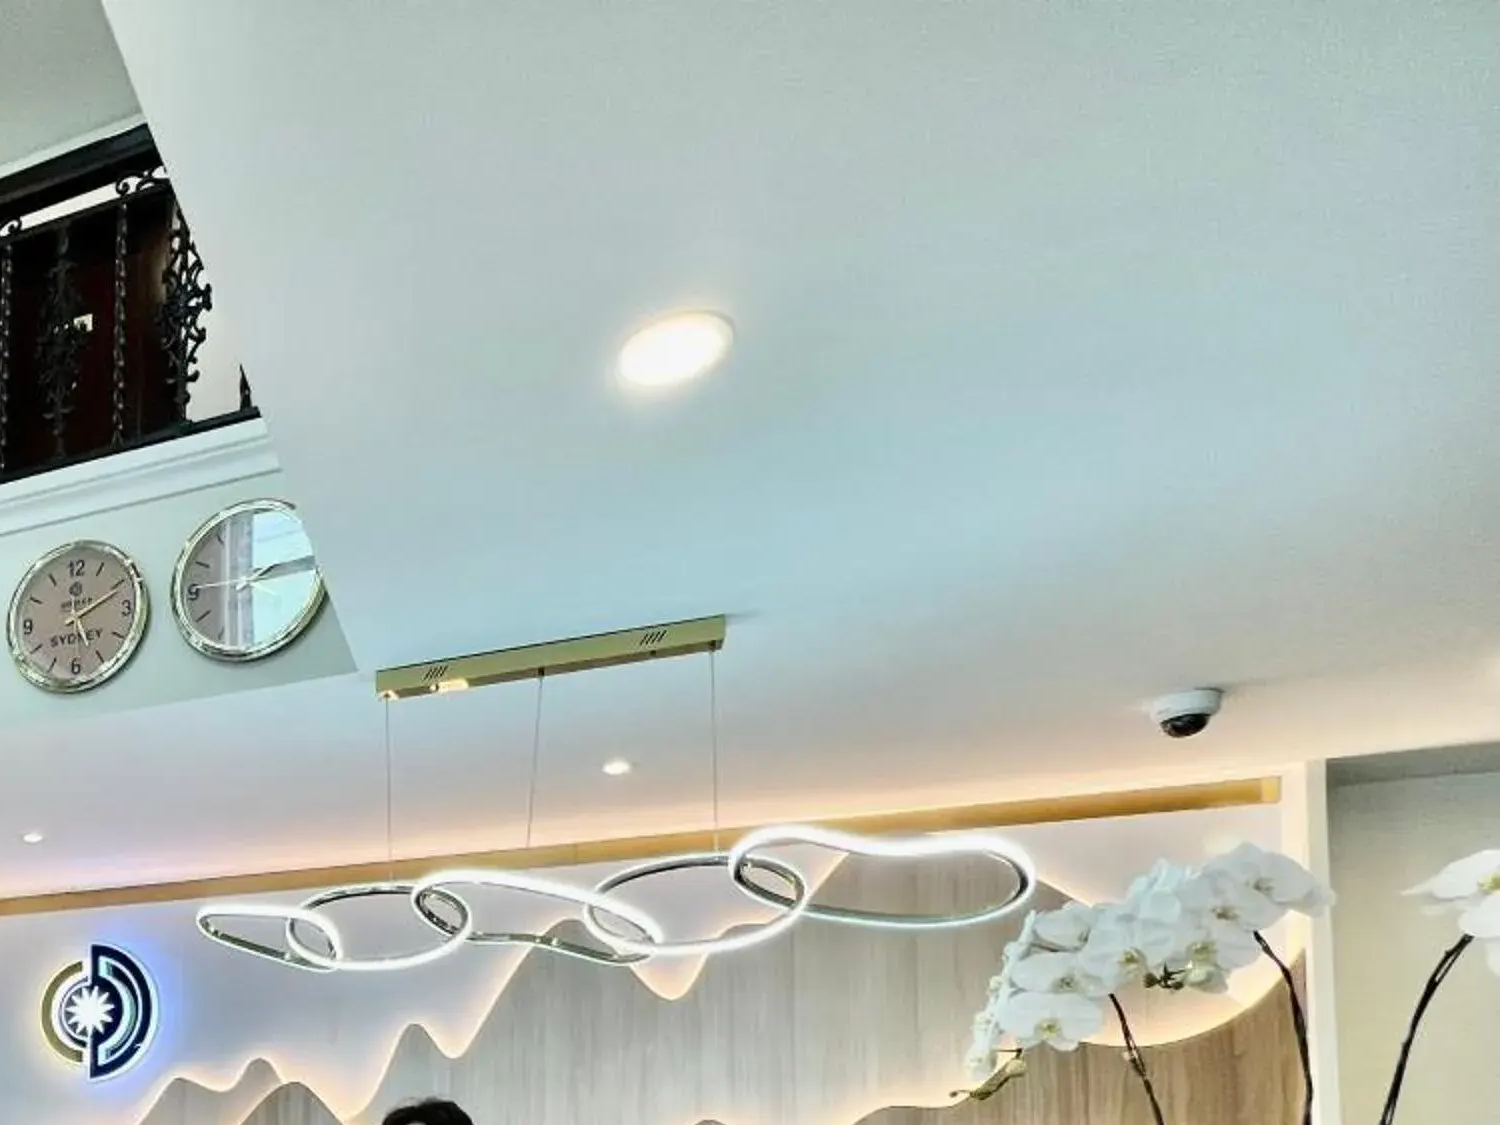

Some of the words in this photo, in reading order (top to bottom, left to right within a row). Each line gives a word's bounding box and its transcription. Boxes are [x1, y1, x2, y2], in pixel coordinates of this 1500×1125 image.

[68, 560, 85, 577] 12
[188, 583, 199, 600] 9
[121, 600, 131, 617] 3
[23, 619, 33, 635] 9
[50, 628, 103, 648] SYDNEY
[70, 657, 81, 675] 6
